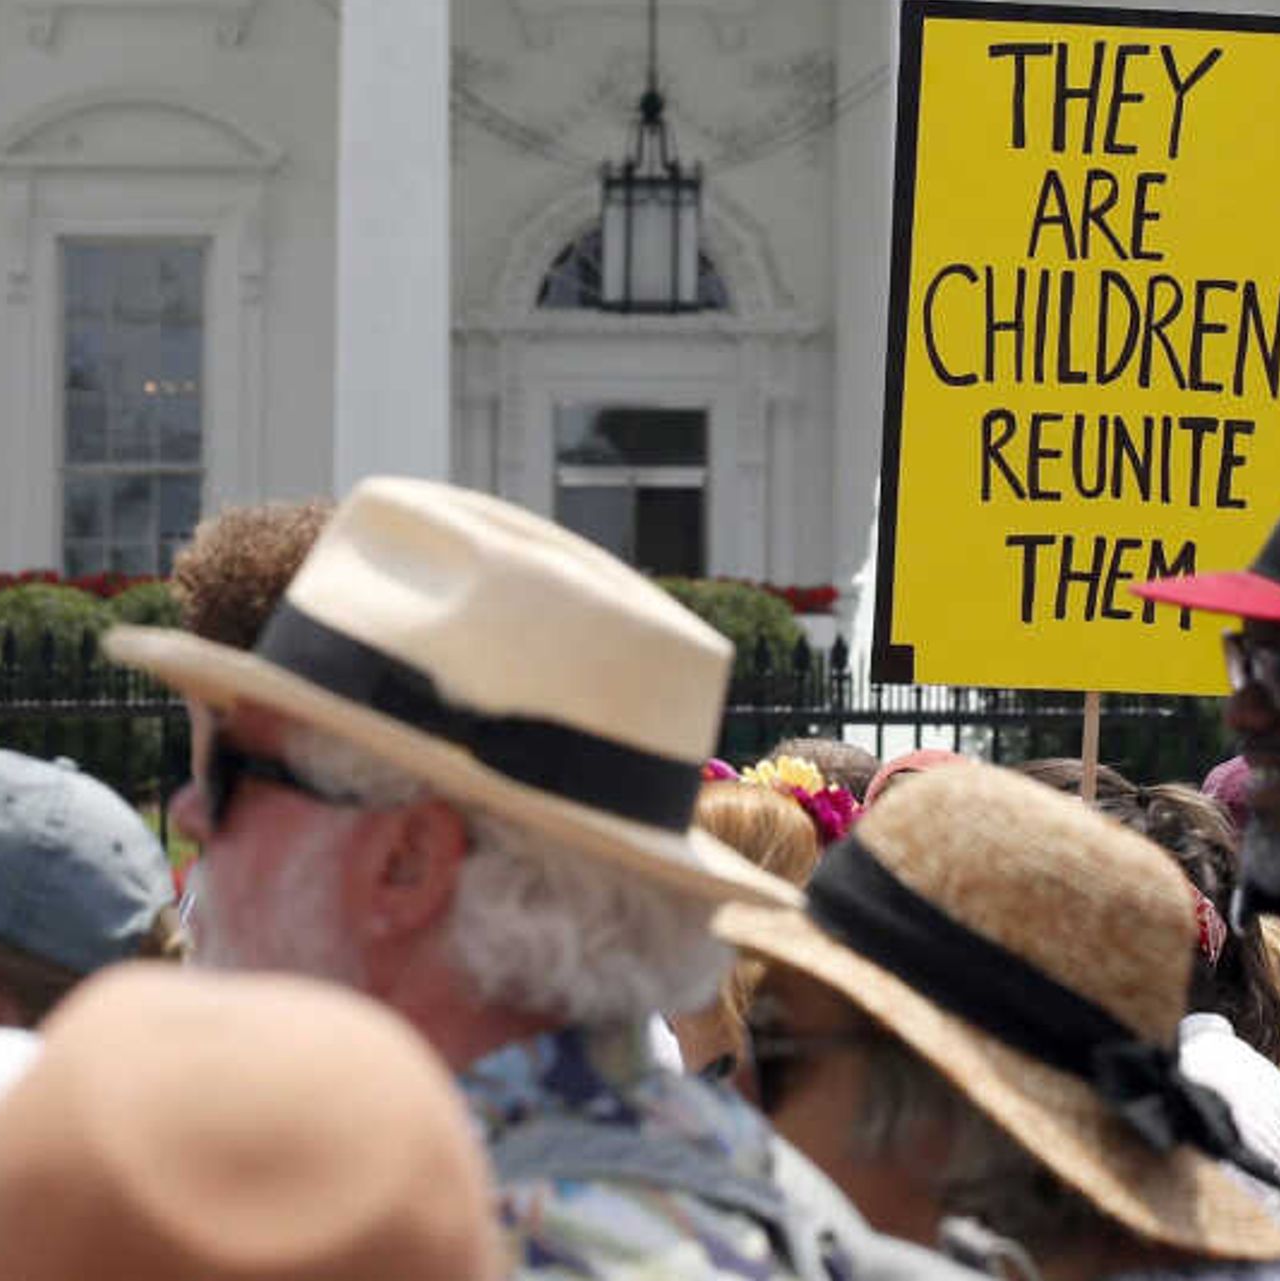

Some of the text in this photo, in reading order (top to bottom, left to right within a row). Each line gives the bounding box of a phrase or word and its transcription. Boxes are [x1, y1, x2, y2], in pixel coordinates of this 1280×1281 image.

[988, 40, 1223, 159] THEY
[1028, 169, 1167, 261] ARE
[980, 408, 1255, 509] REUNITE
[1006, 534, 1196, 630] THEM
